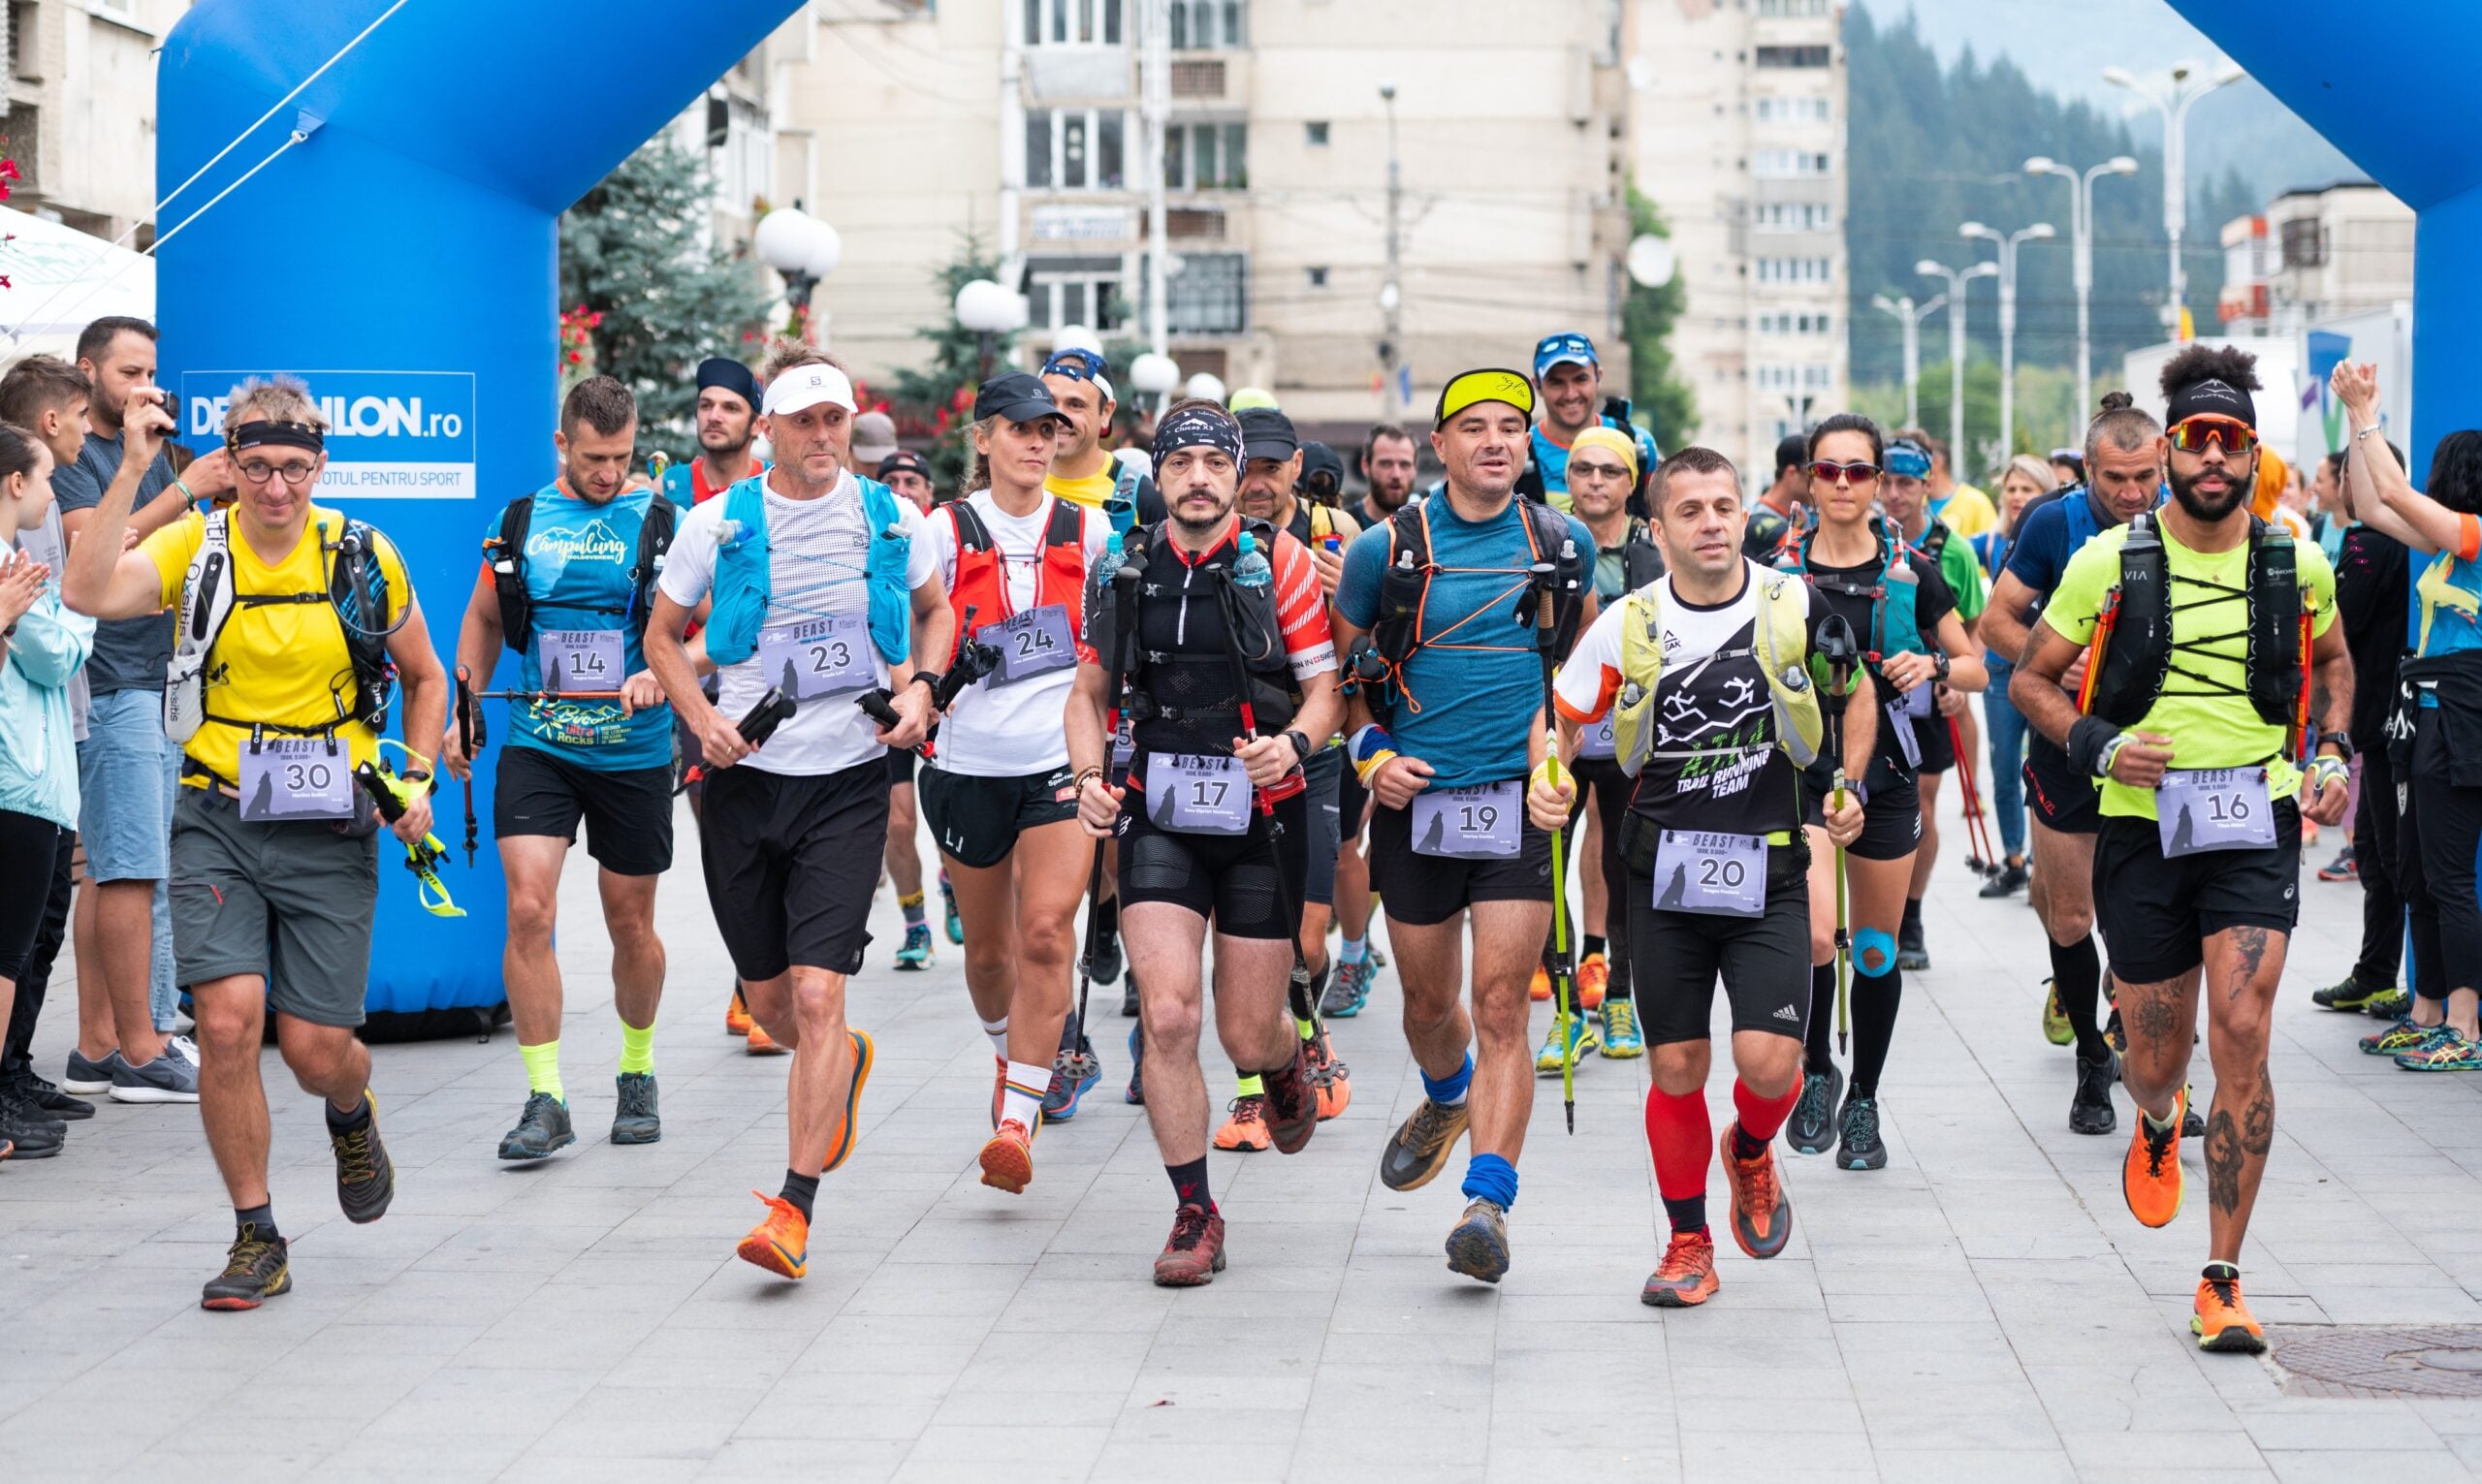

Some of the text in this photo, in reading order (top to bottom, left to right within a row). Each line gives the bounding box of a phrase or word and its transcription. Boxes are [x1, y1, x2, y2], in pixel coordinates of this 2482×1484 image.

[191, 395, 462, 437] DELON.ro
[362, 471, 420, 486] PENTRU
[420, 471, 461, 486] SPORT
[527, 532, 628, 565] Câmpulung
[2124, 570, 2148, 581] VIA
[561, 632, 596, 643] BEAST
[793, 620, 834, 640] BEAST
[1014, 628, 1055, 657] 24
[1665, 640, 1682, 651] EAK
[570, 651, 606, 675] 14
[810, 642, 851, 673] 23
[275, 741, 317, 753] BEAST
[557, 732, 594, 744] Rocks
[285, 763, 332, 791] 30
[1712, 774, 1750, 799] TEAM
[2192, 770, 2235, 784] BEAST
[1192, 779, 1230, 807] 17
[1459, 805, 1499, 832] 19
[2208, 793, 2250, 822] 16
[1693, 834, 1735, 848] BEAST
[1699, 857, 1745, 887] 20
[1772, 1011, 1799, 1022] adidas
